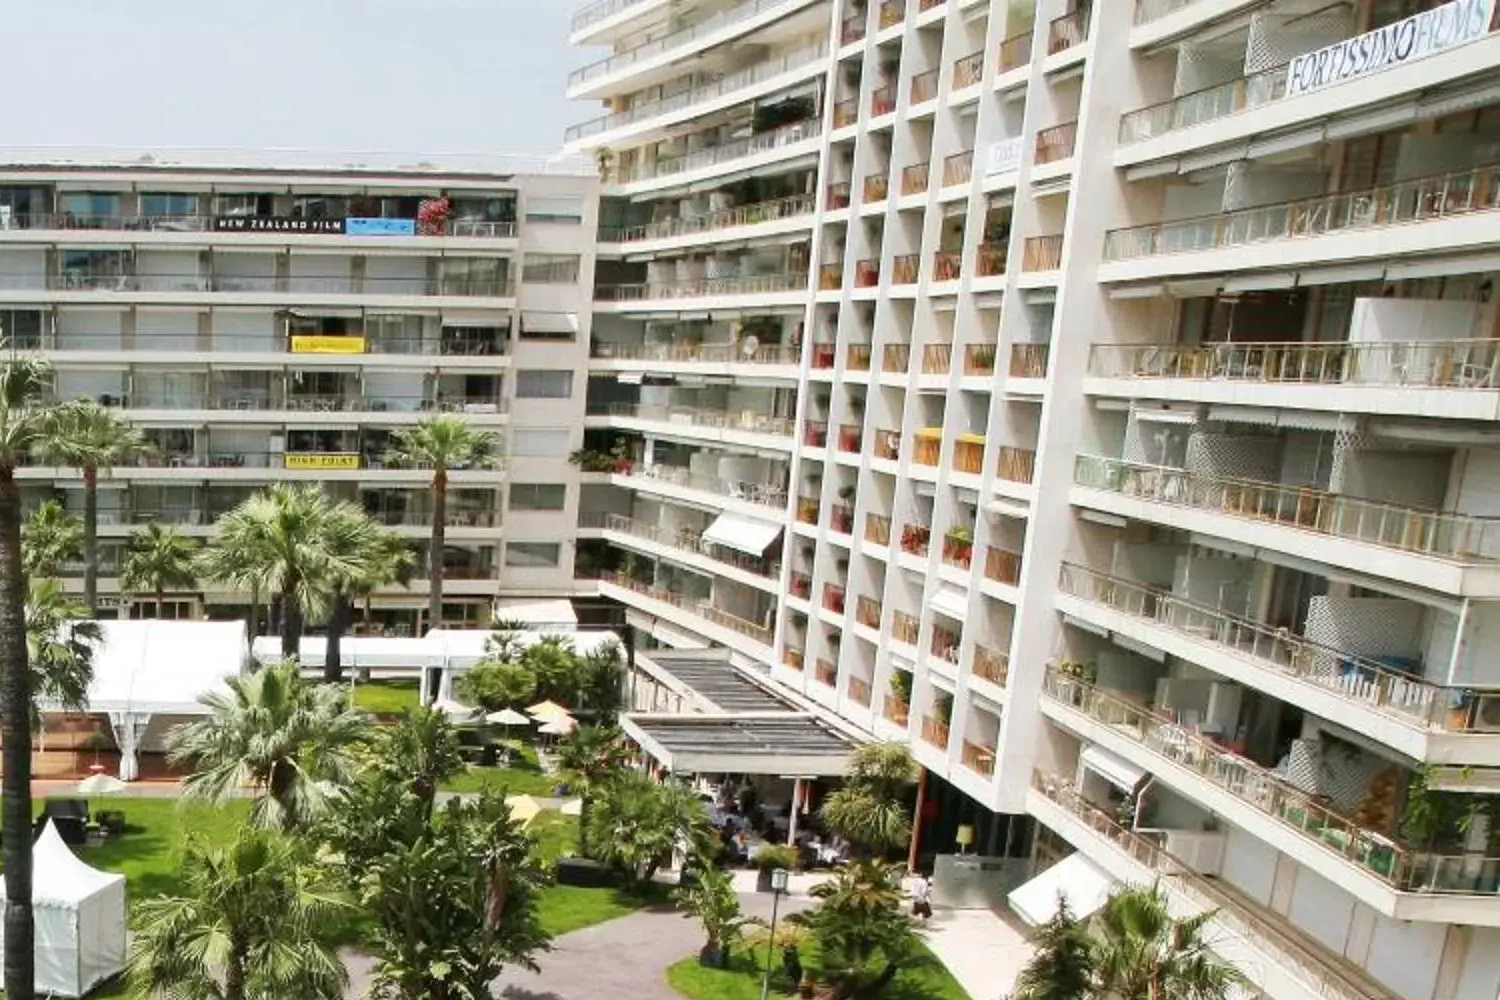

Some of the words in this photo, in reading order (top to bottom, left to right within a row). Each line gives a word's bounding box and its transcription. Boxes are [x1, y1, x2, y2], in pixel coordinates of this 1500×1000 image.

[219, 219, 244, 228] NEW
[251, 220, 307, 229] ZEALAND
[313, 221, 341, 230] FILM
